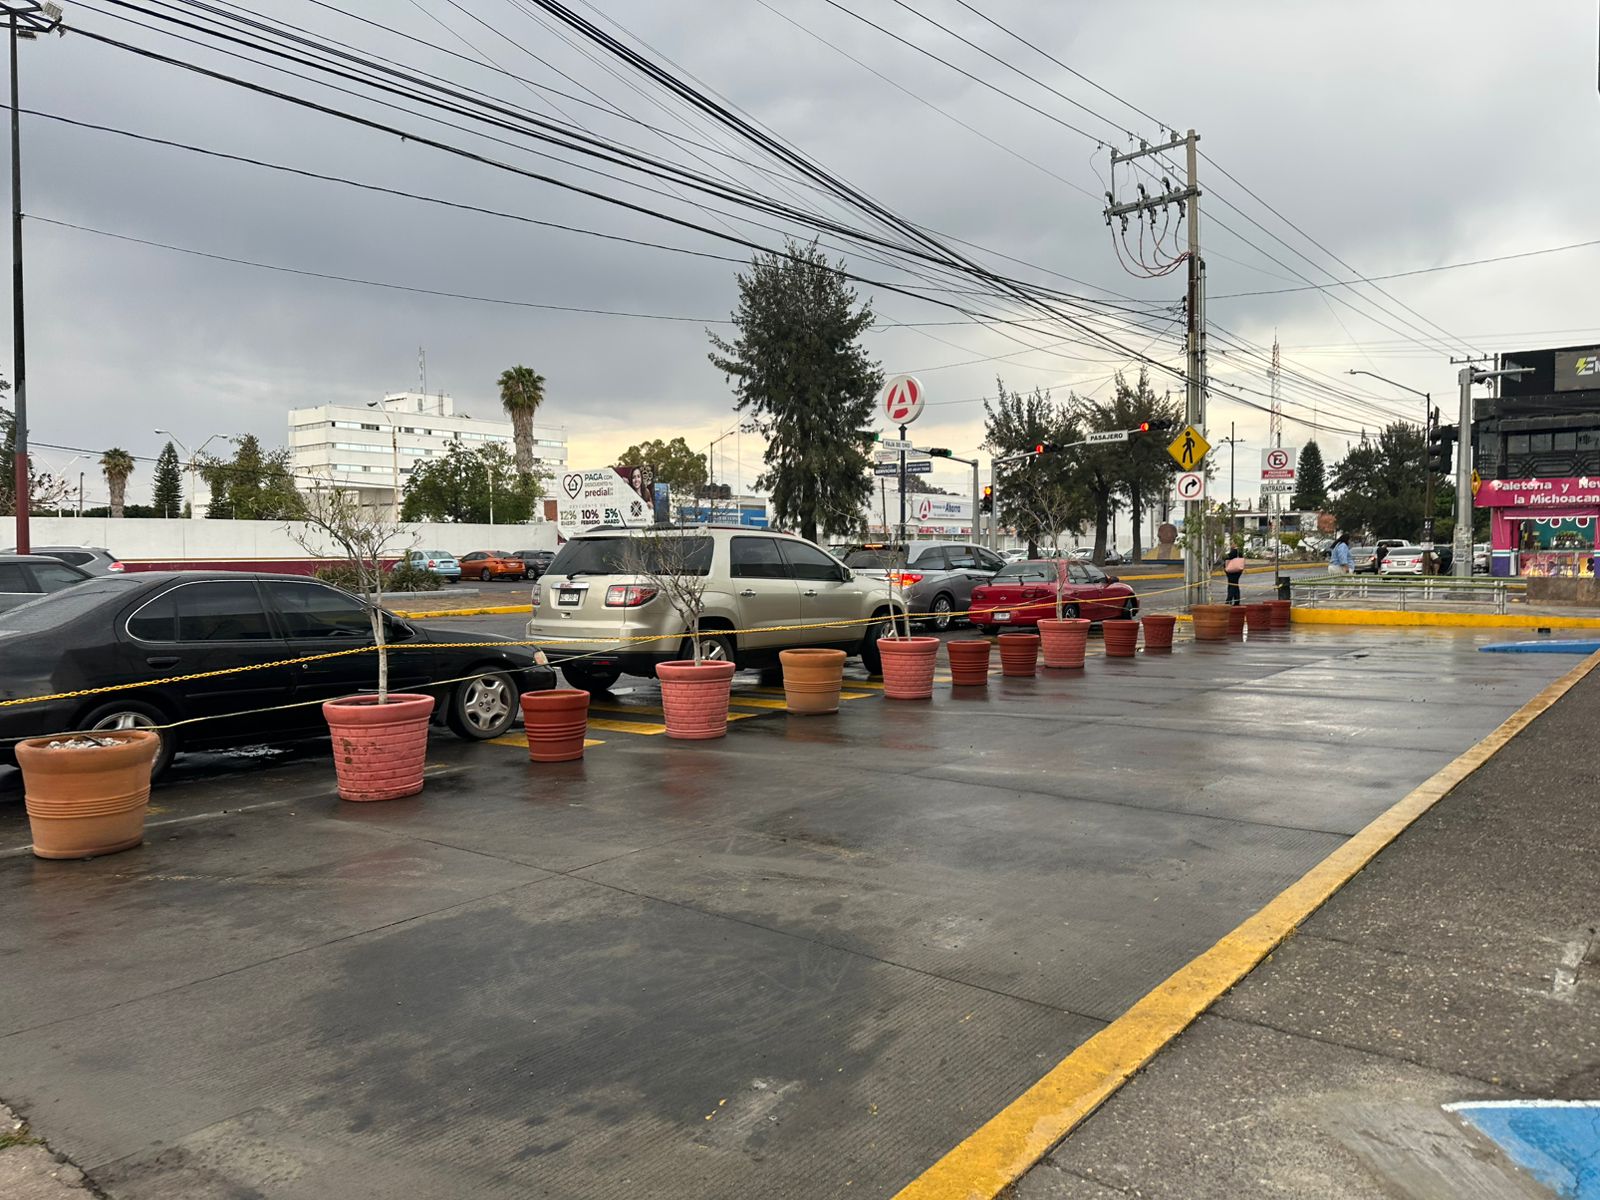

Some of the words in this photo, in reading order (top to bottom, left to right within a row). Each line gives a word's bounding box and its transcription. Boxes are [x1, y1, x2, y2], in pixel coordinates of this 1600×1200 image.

[1090, 432, 1123, 442] PASAJERO
[584, 473, 603, 481] PAGA
[584, 487, 610, 498] predial
[1561, 483, 1570, 493] y
[1514, 494, 1525, 504] la
[560, 510, 577, 520] 12%
[581, 509, 599, 519] 10%
[604, 508, 618, 519] 5%
